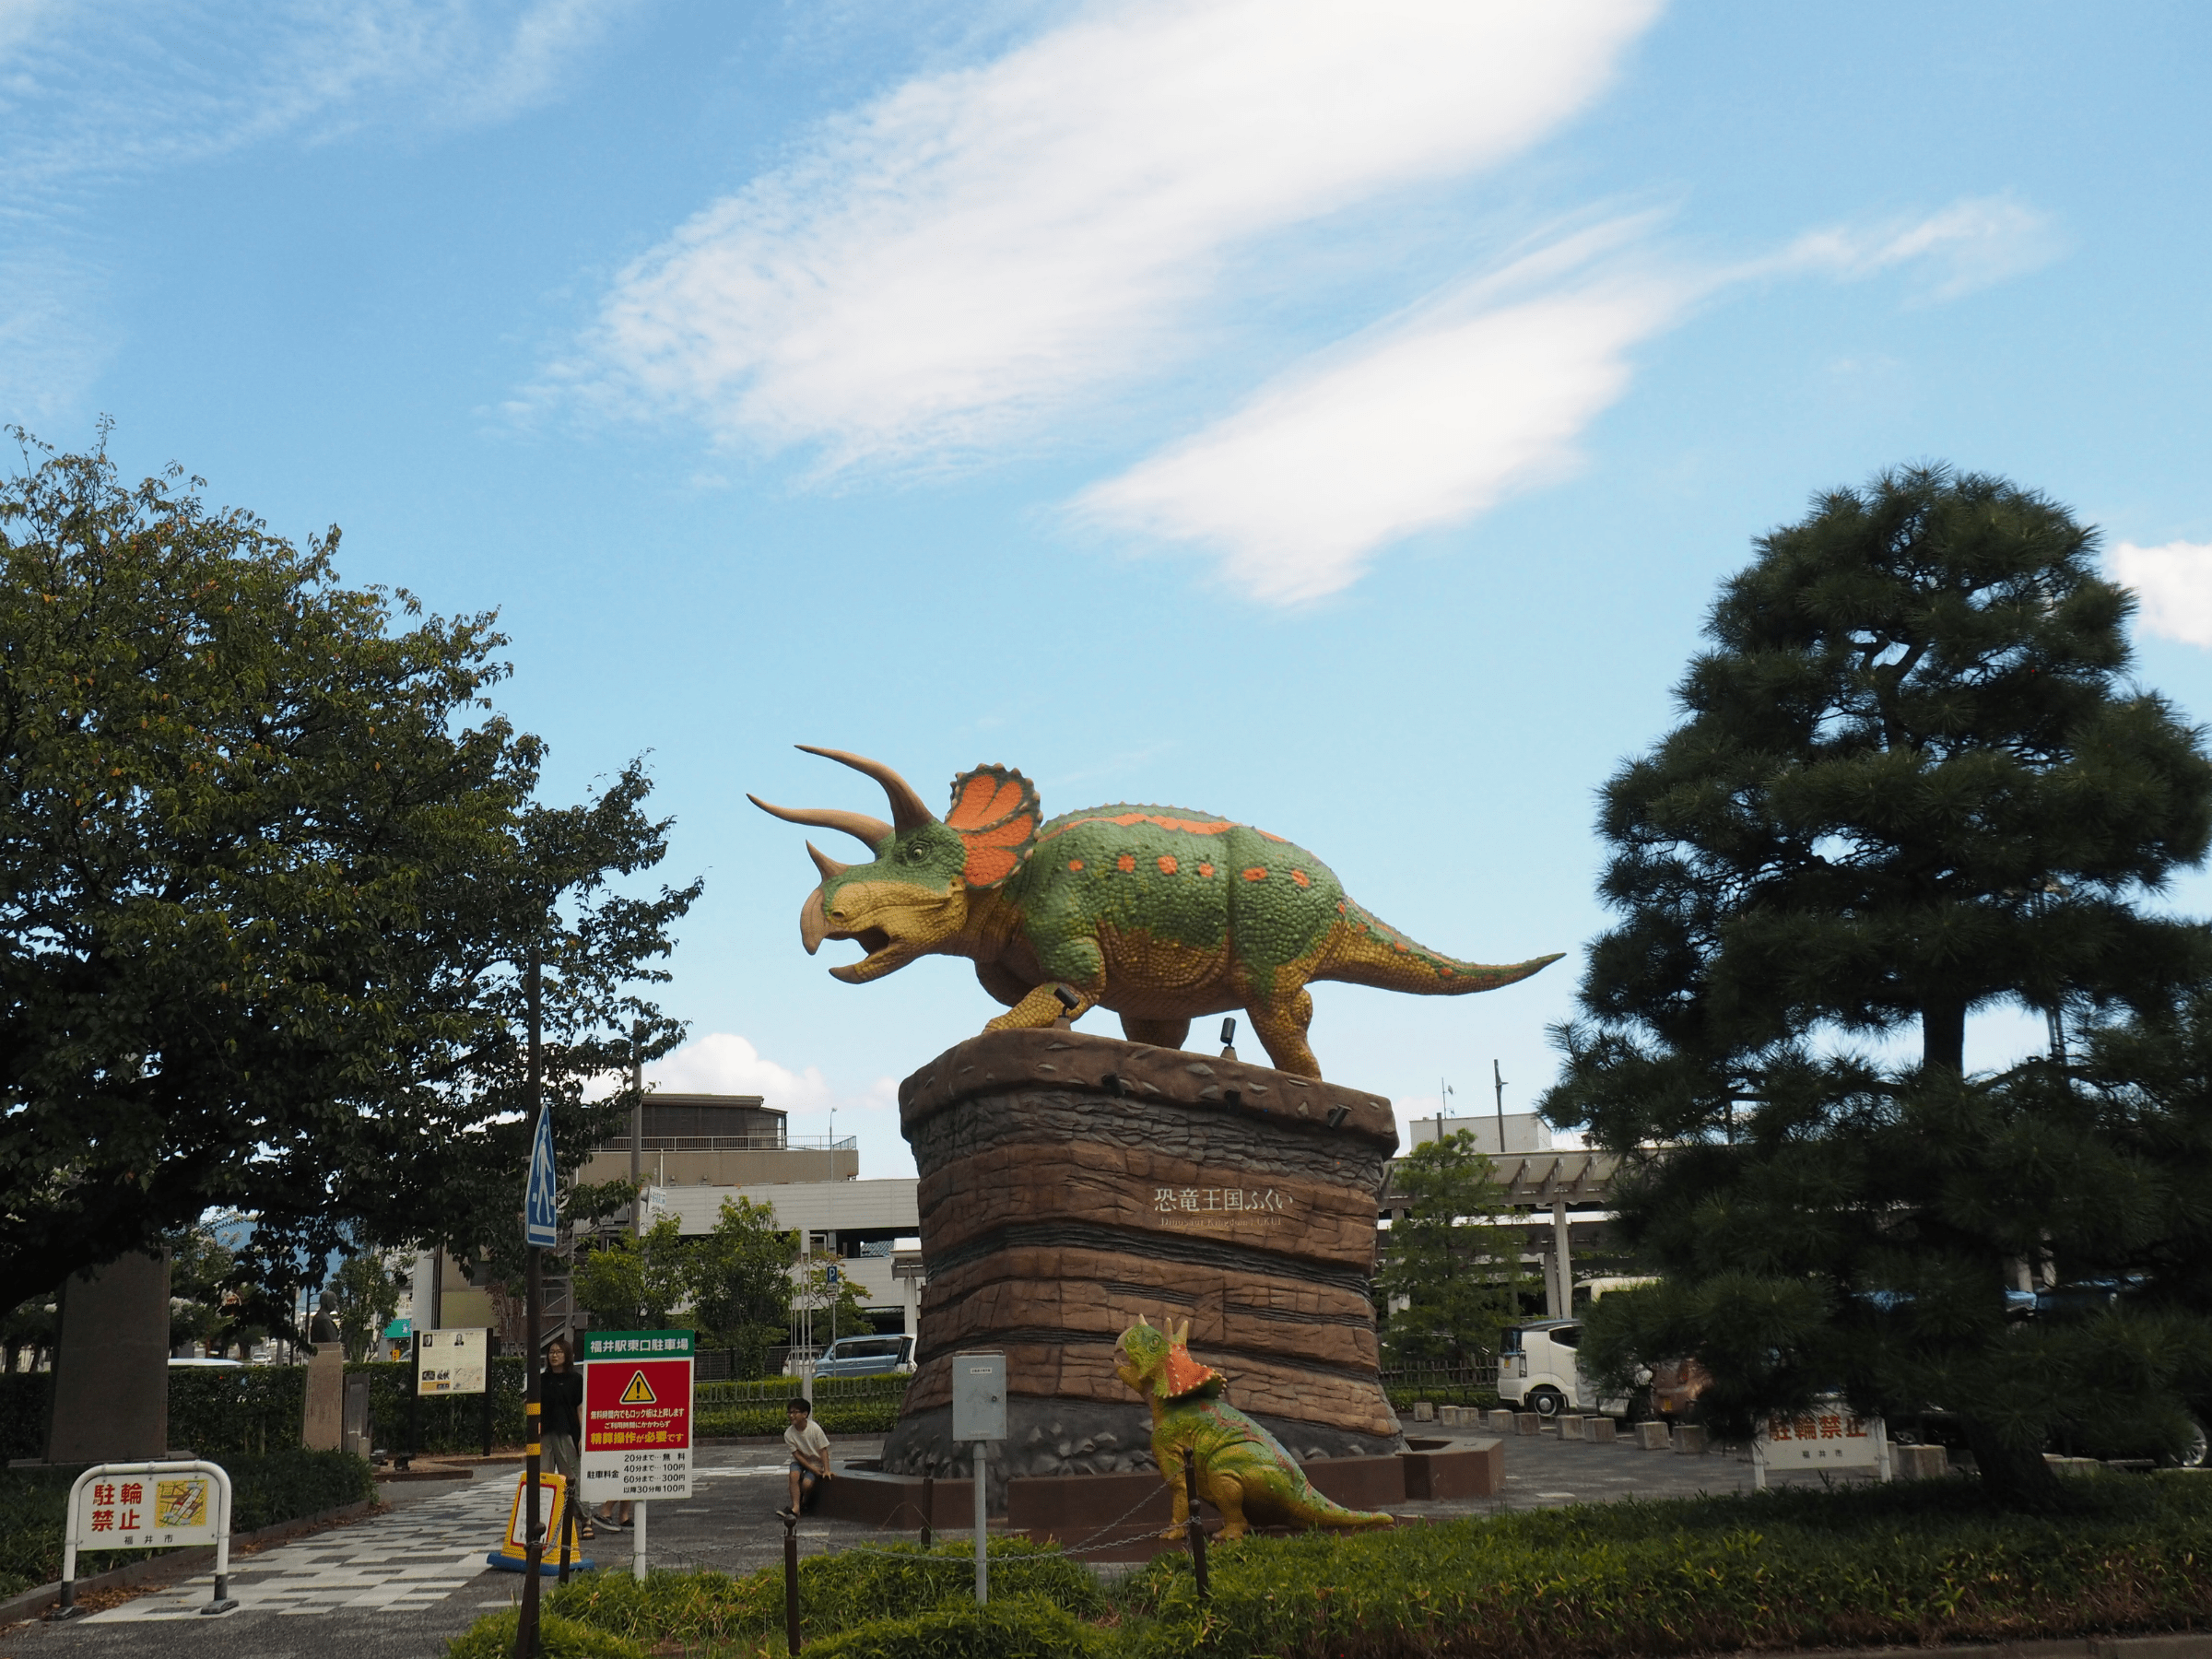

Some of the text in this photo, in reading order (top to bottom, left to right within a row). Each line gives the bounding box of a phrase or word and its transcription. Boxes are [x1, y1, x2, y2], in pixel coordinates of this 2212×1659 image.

[1154, 1187, 1293, 1212] 恐竜王国ふくい
[830, 1267, 836, 1281] P
[590, 1337, 689, 1353] 福井駅東口駐車場
[590, 1430, 684, 1445] 精算操作が必要です
[586, 1469, 619, 1479] 駐車料金
[92, 1482, 143, 1506] 駐輪
[91, 1508, 141, 1532] 禁止
[124, 1534, 173, 1545] 福井市
